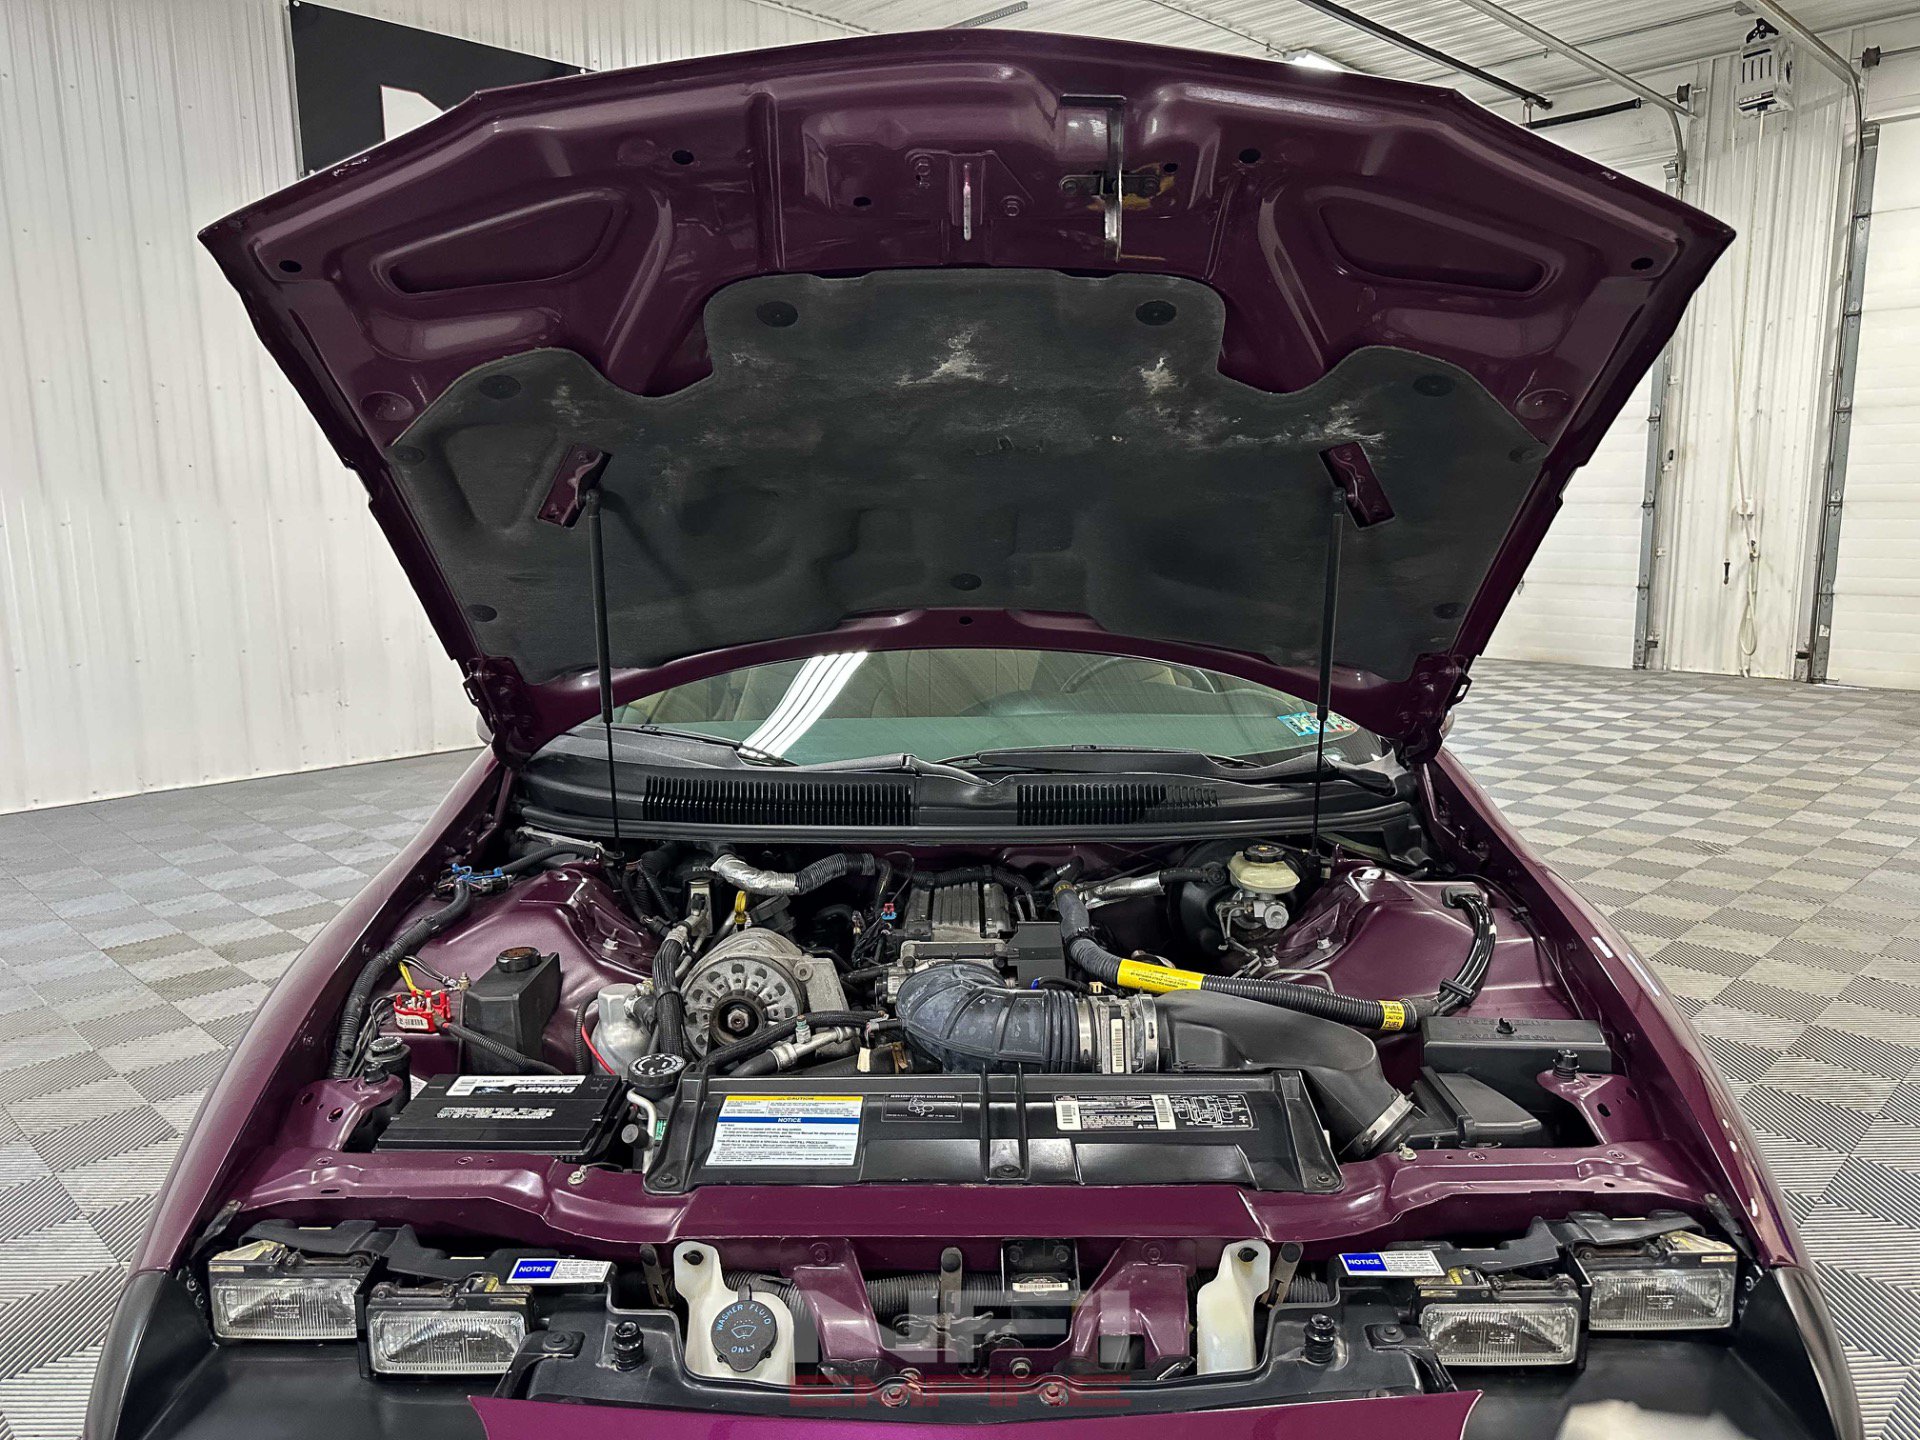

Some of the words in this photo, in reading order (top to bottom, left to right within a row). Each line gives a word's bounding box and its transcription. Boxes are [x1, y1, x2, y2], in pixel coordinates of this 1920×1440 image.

[1347, 1258, 1382, 1266] NOTICE
[518, 1265, 553, 1273] NOTICE
[716, 1304, 744, 1331] WASHER
[749, 1303, 772, 1325] FLUID
[731, 1343, 756, 1353] ONLY
